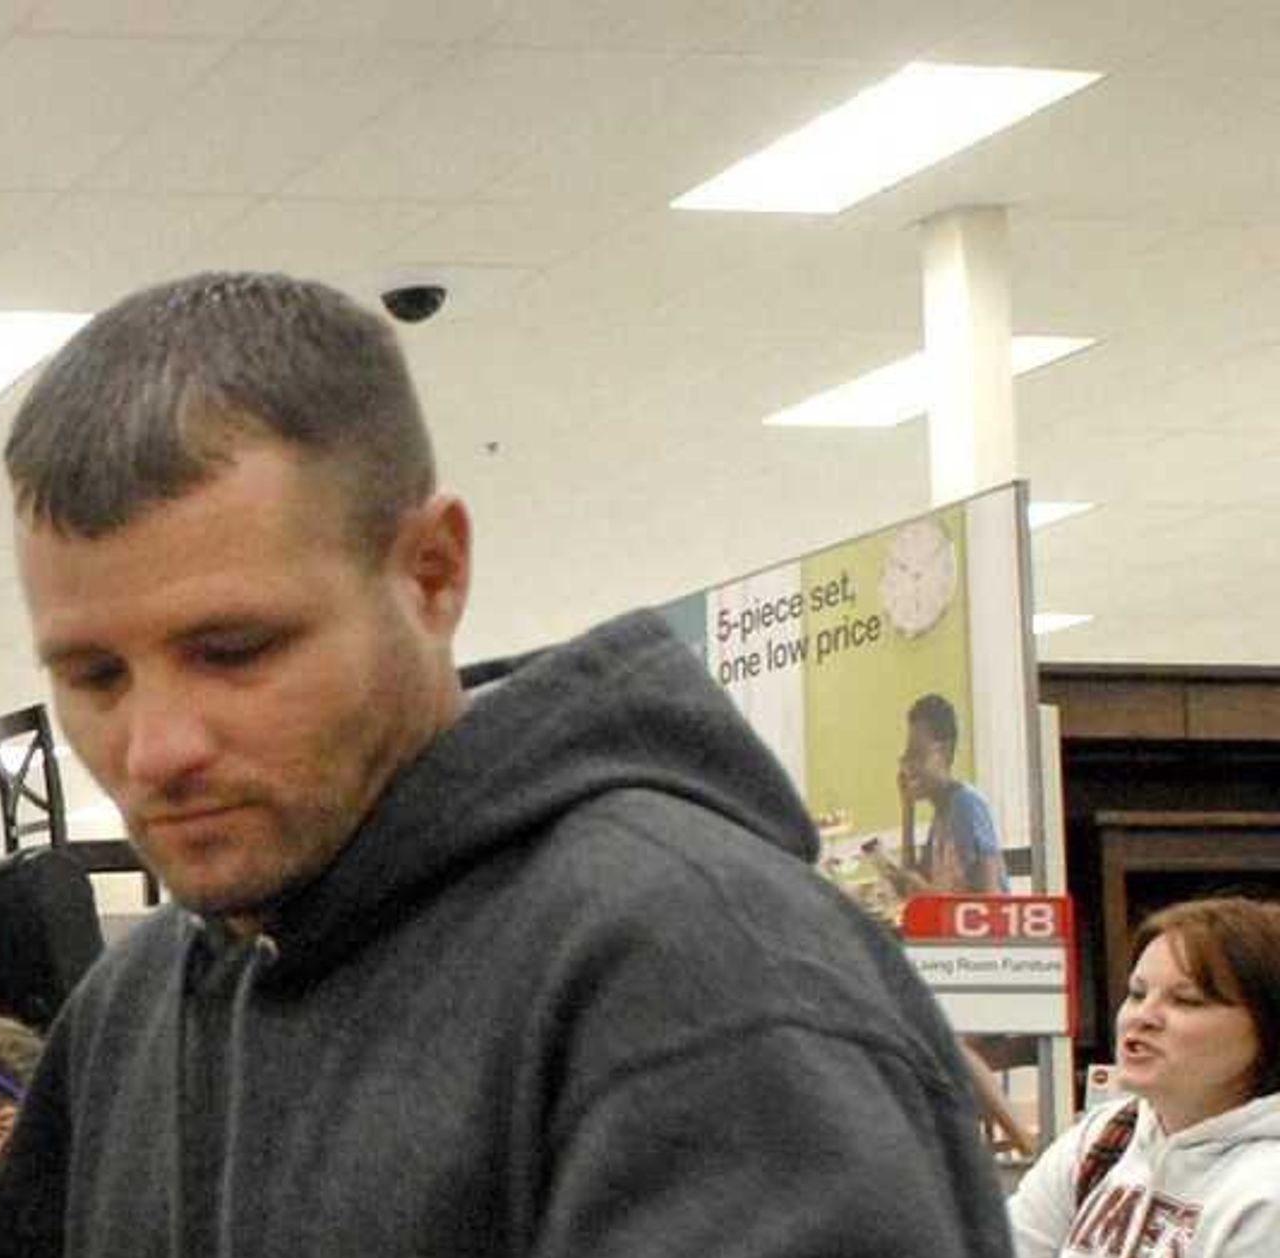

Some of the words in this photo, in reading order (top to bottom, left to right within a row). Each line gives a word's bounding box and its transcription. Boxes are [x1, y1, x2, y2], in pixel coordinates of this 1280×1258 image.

[716, 592, 804, 643] 5-piece
[810, 571, 856, 612] set,
[719, 651, 760, 684] one
[767, 635, 809, 672] low
[817, 613, 882, 665] price
